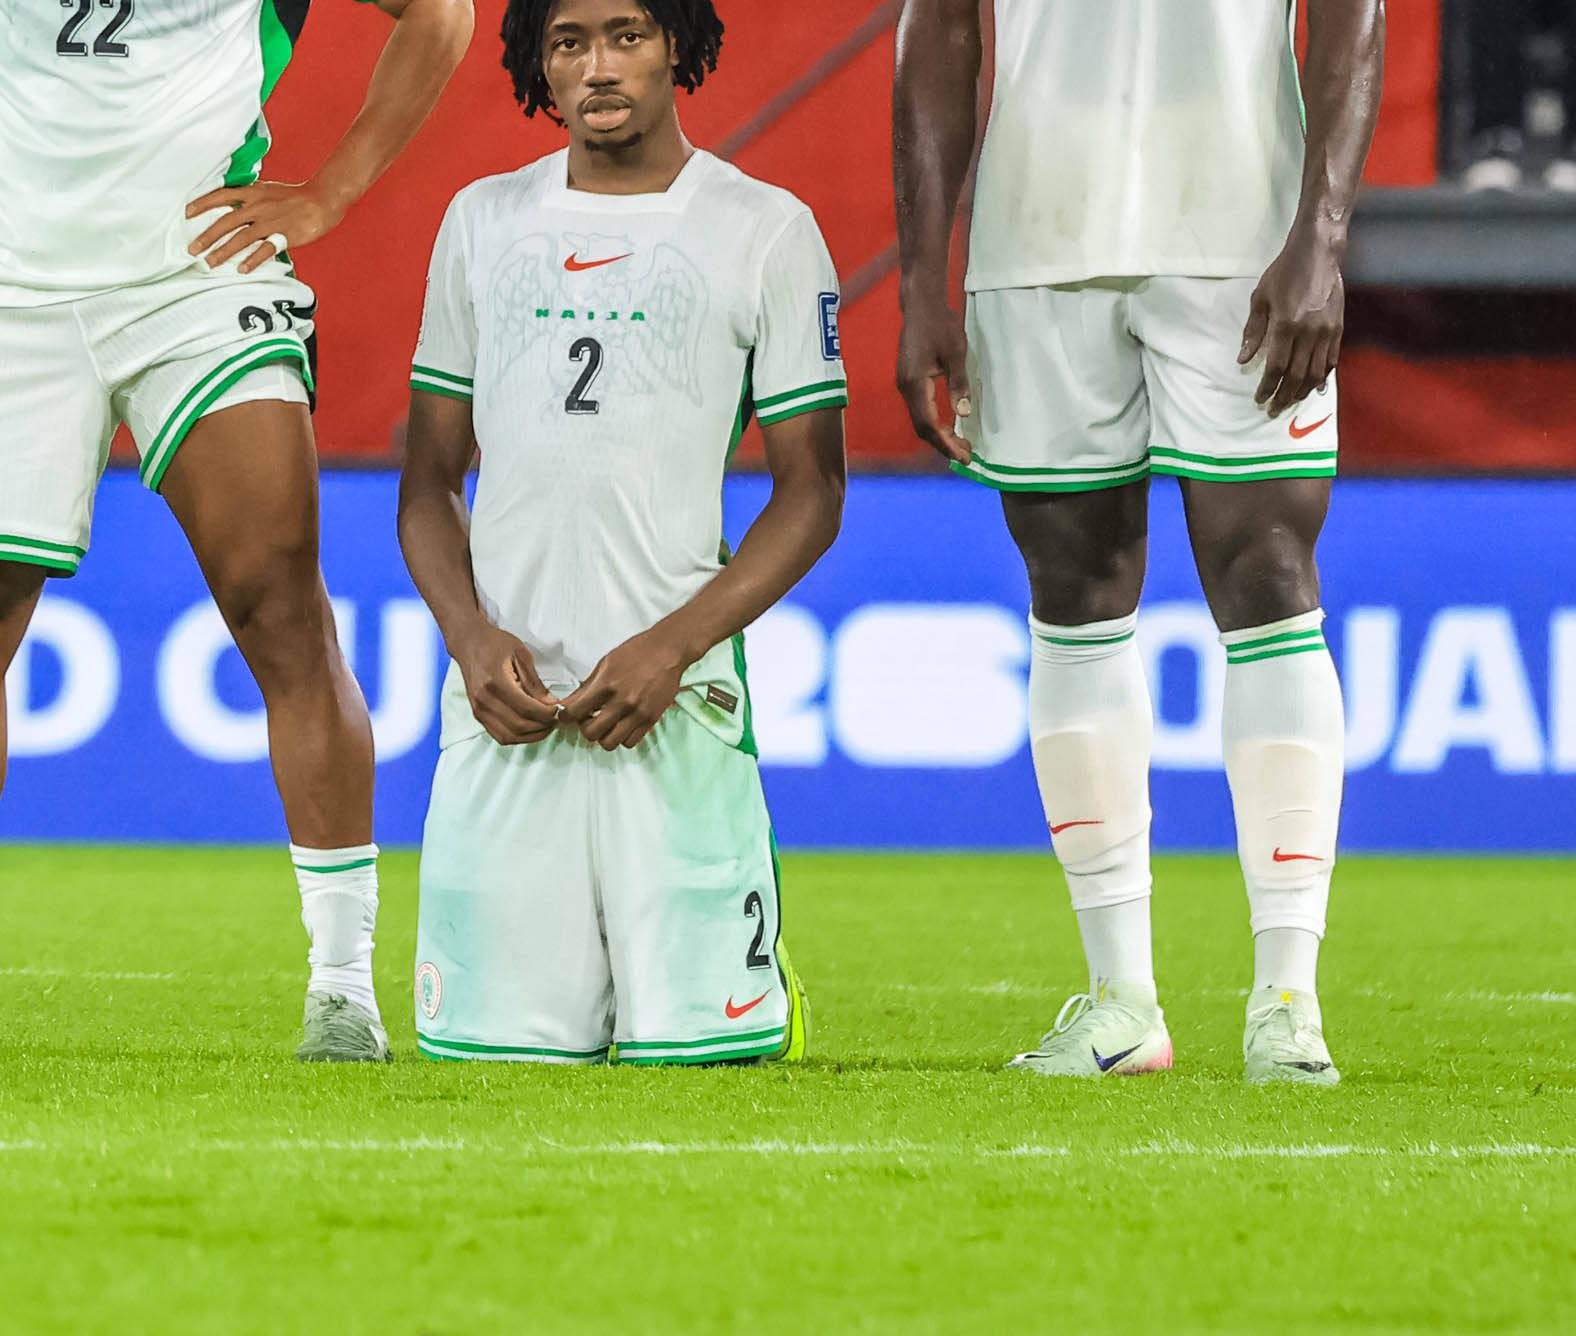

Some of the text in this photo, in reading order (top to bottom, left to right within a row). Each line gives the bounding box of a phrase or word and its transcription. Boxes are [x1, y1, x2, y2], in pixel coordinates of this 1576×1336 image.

[536, 309, 645, 321] NAIJA
[565, 337, 603, 415] 2
[155, 595, 440, 764] CU
[743, 890, 771, 970] 2
